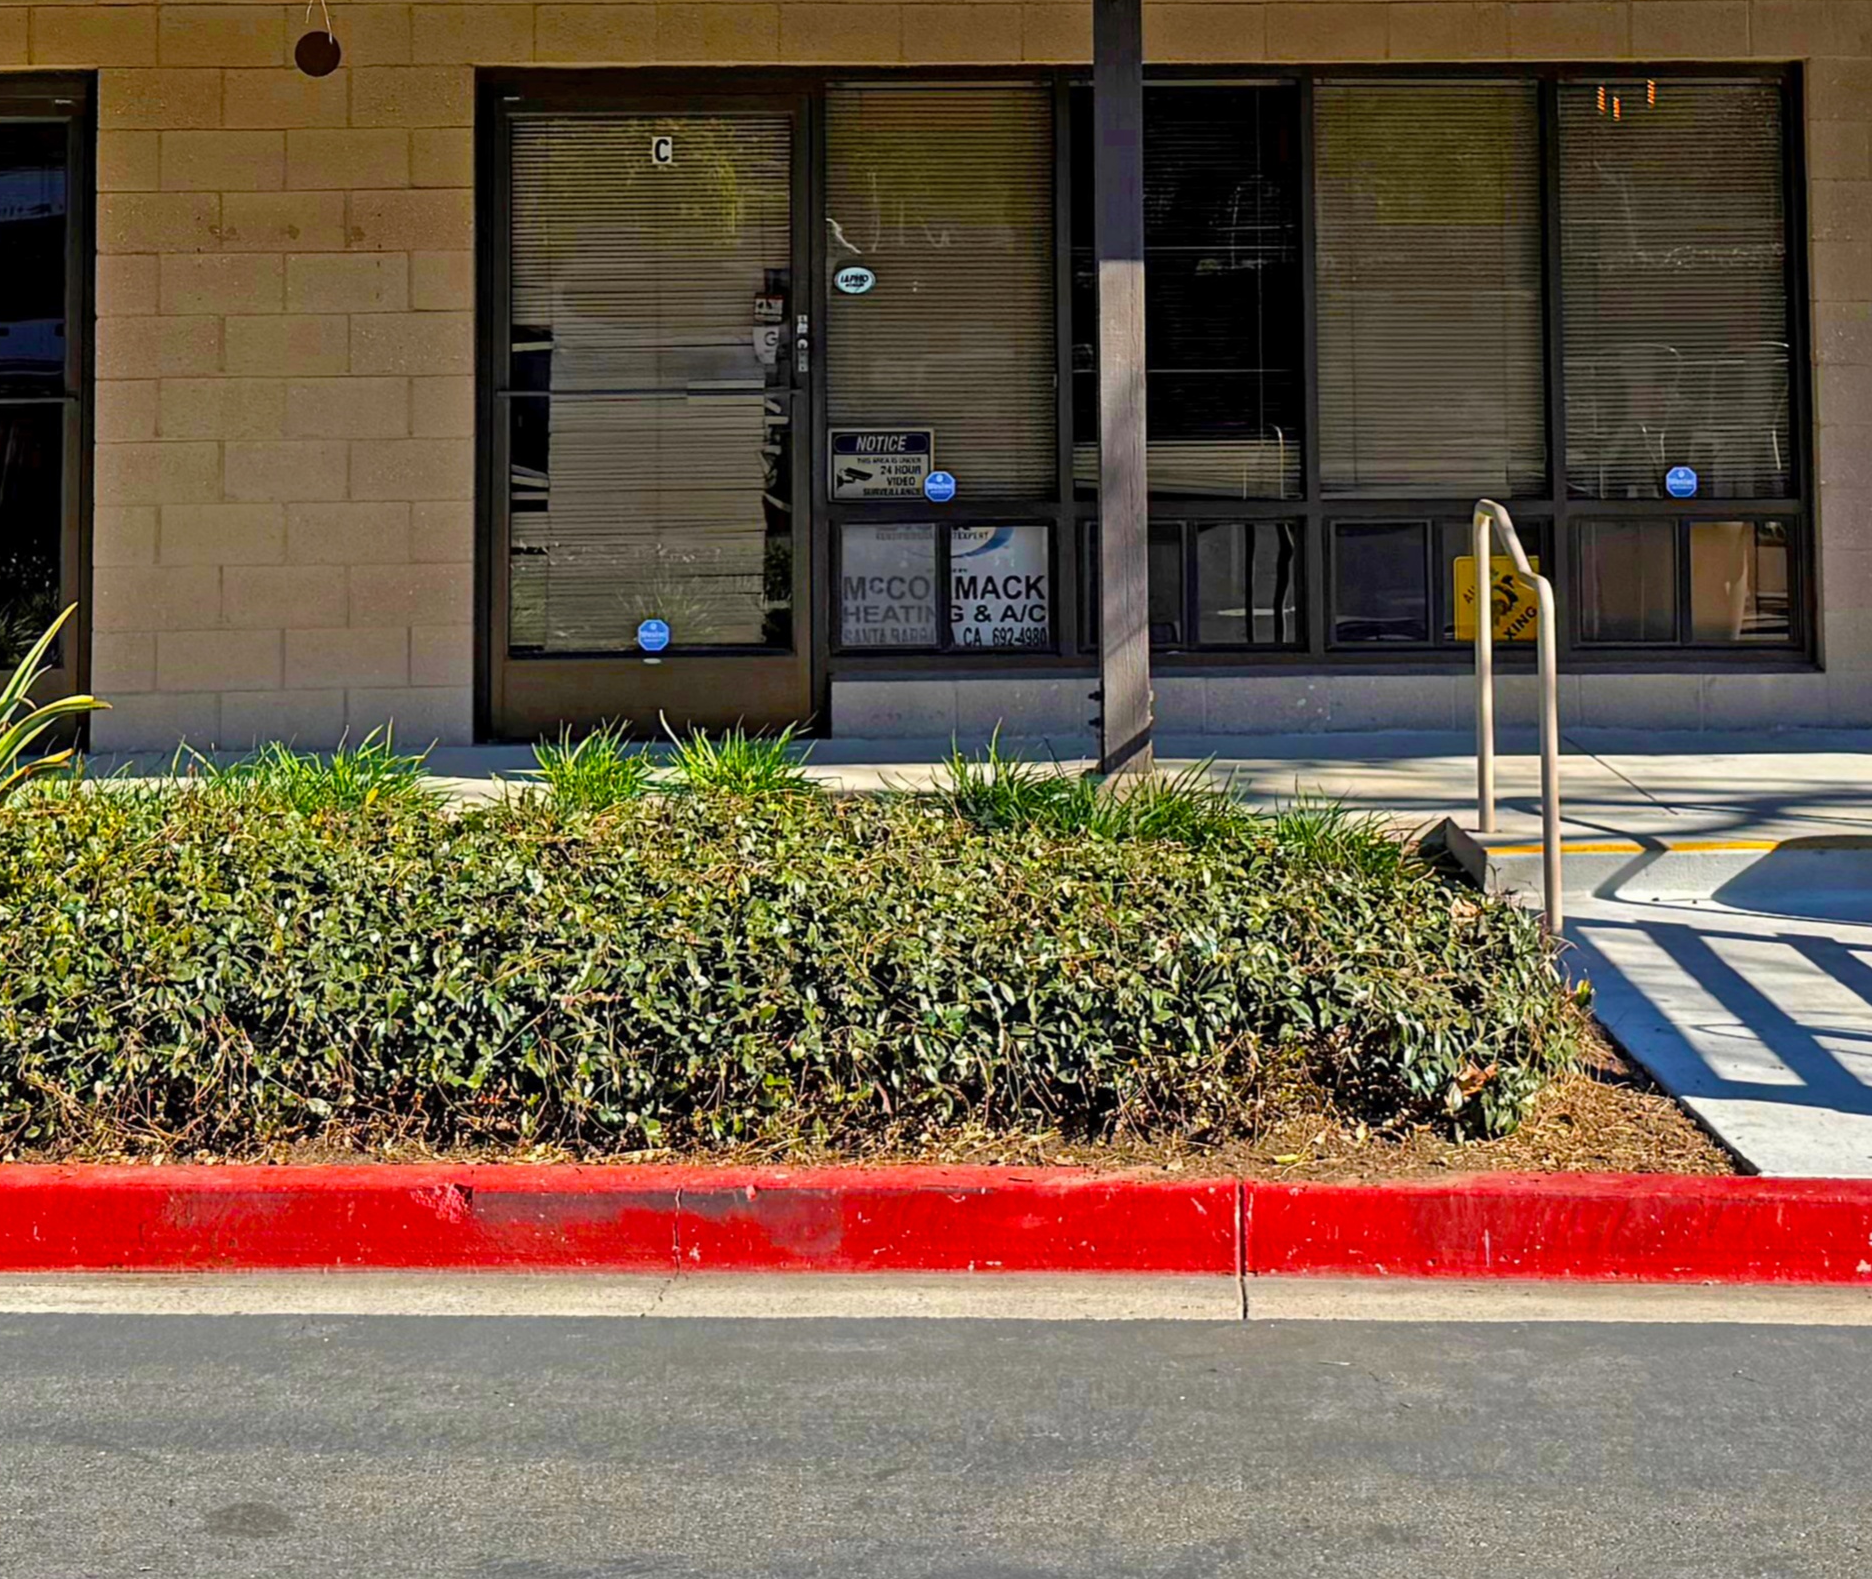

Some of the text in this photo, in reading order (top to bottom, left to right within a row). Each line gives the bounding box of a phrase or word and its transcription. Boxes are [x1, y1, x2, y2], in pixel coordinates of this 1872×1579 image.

[654, 138, 670, 163] C
[856, 435, 907, 451] NOTICE
[880, 465, 922, 475] 24 HOUR
[887, 476, 916, 486] VIDEO
[973, 604, 992, 623] &
[999, 604, 1047, 623] A/C
[1503, 606, 1538, 640] XING
[963, 627, 983, 646] CA
[992, 627, 1047, 646] 692-4980
